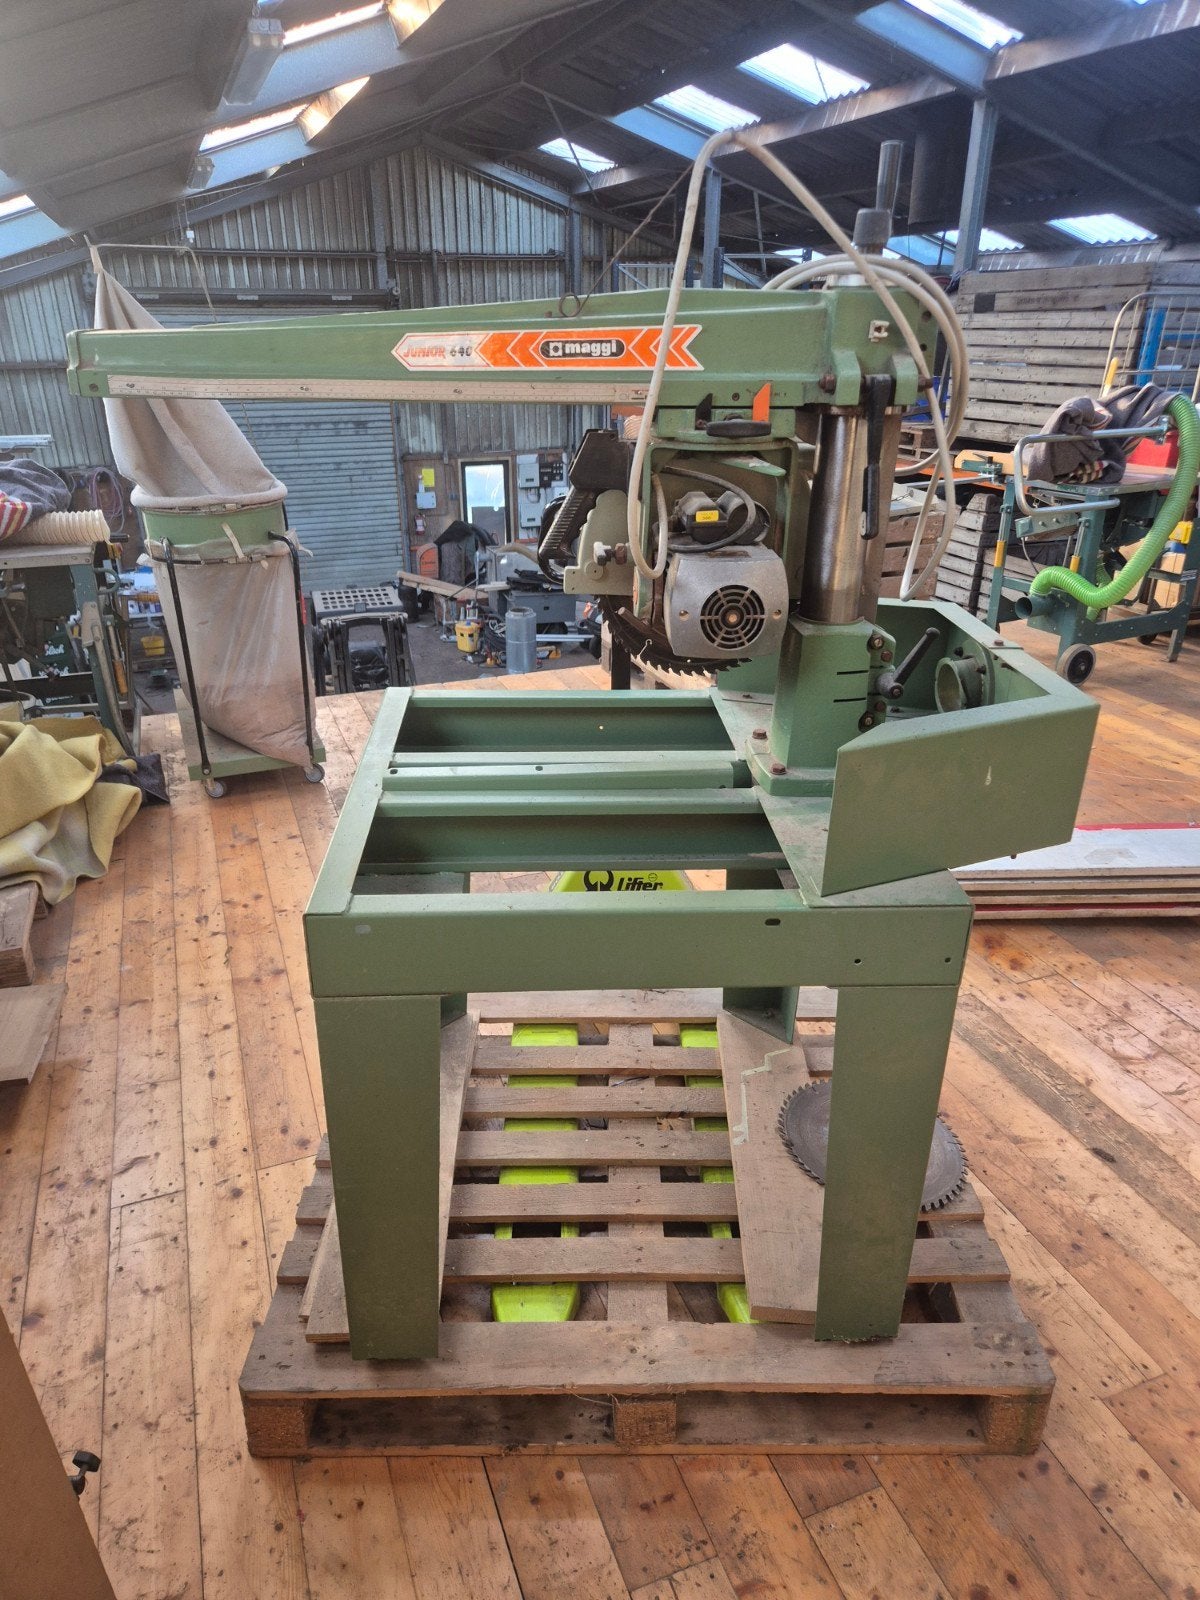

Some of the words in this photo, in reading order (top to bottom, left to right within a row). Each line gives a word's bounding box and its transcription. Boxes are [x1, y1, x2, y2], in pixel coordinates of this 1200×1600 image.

[403, 345, 446, 359] JUNIOR
[450, 345, 473, 357] 640
[564, 339, 617, 357] maggi
